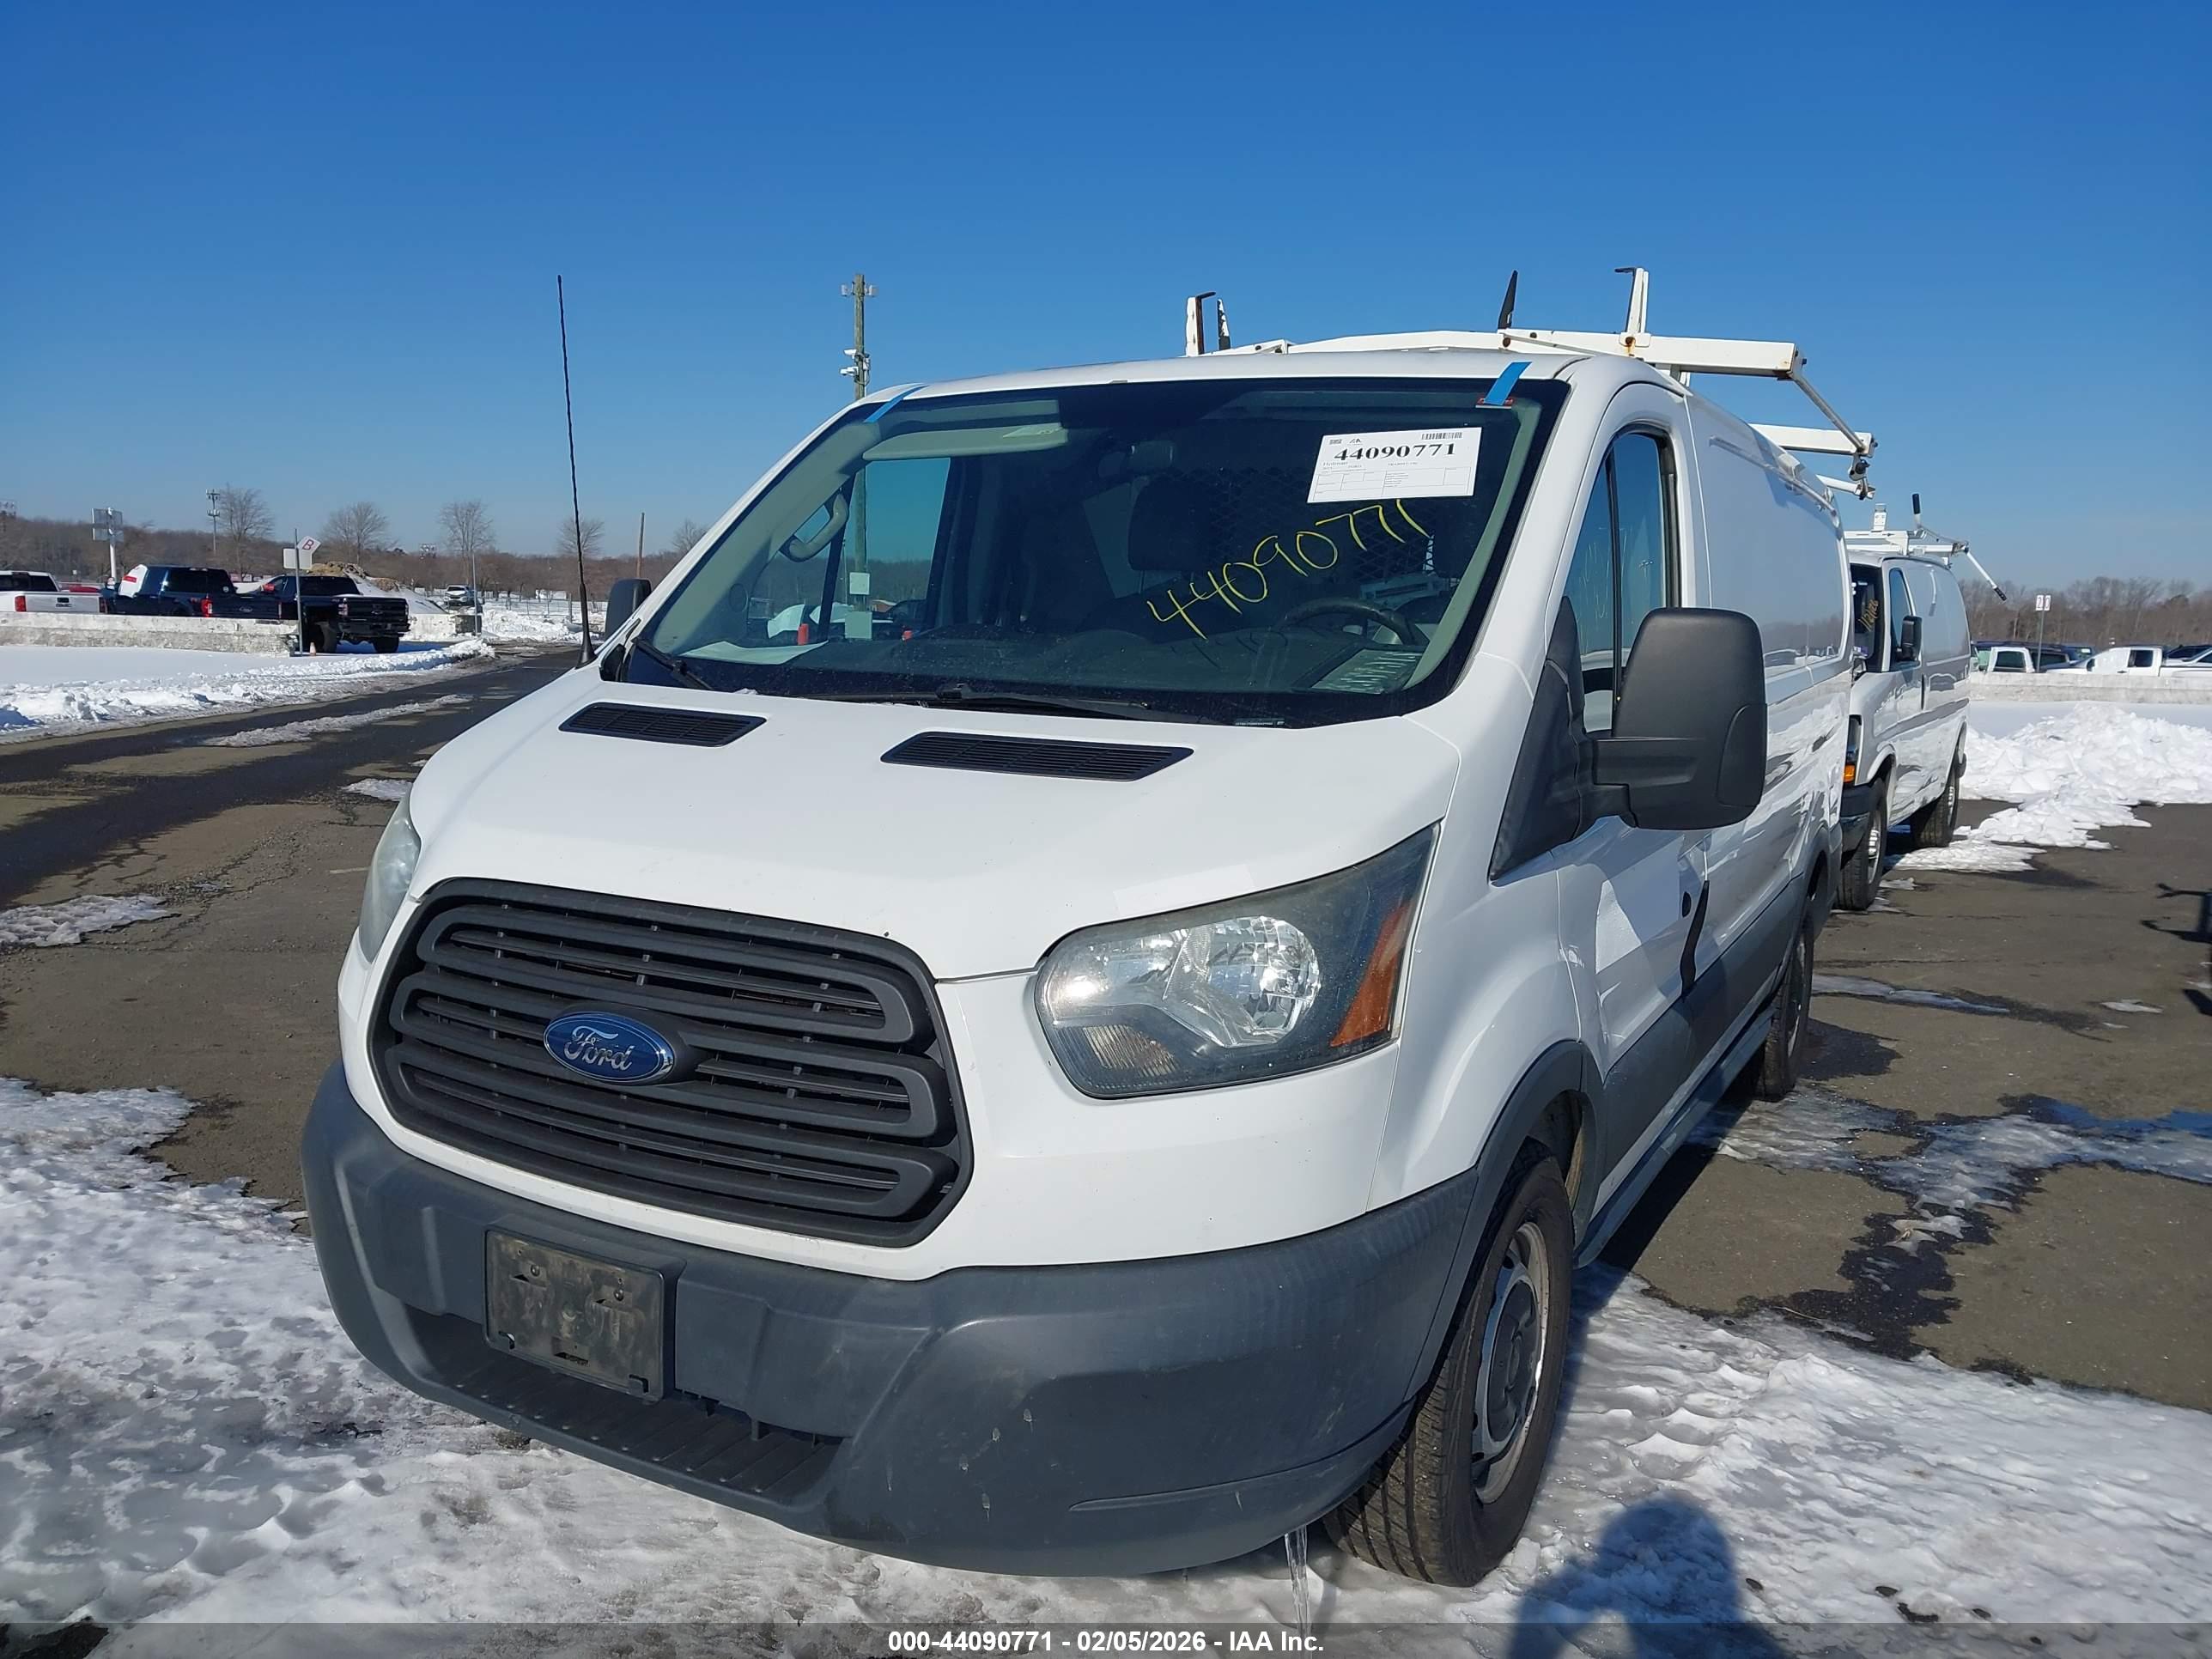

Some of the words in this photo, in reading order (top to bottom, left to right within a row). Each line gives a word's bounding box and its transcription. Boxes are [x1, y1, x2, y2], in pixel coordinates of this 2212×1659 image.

[1334, 443, 1456, 461] 44090771
[1146, 499, 1431, 641] 44090771
[563, 1025, 635, 1071] Ford
